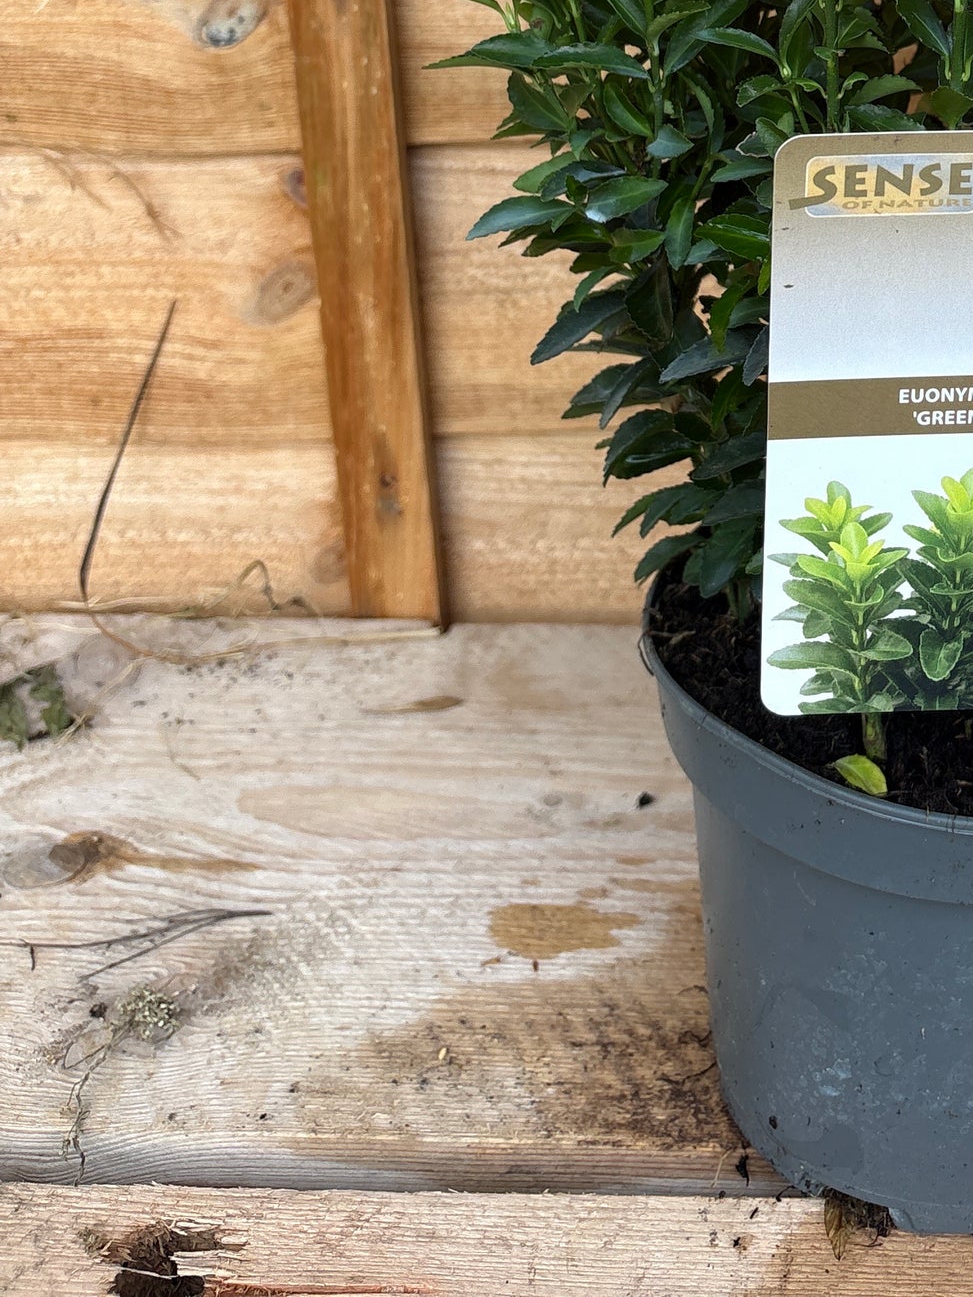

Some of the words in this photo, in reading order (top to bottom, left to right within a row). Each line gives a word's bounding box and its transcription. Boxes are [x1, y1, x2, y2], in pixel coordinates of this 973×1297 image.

[789, 162, 973, 210] SENSE
[841, 199, 873, 210] OF
[878, 197, 972, 209] NATURE
